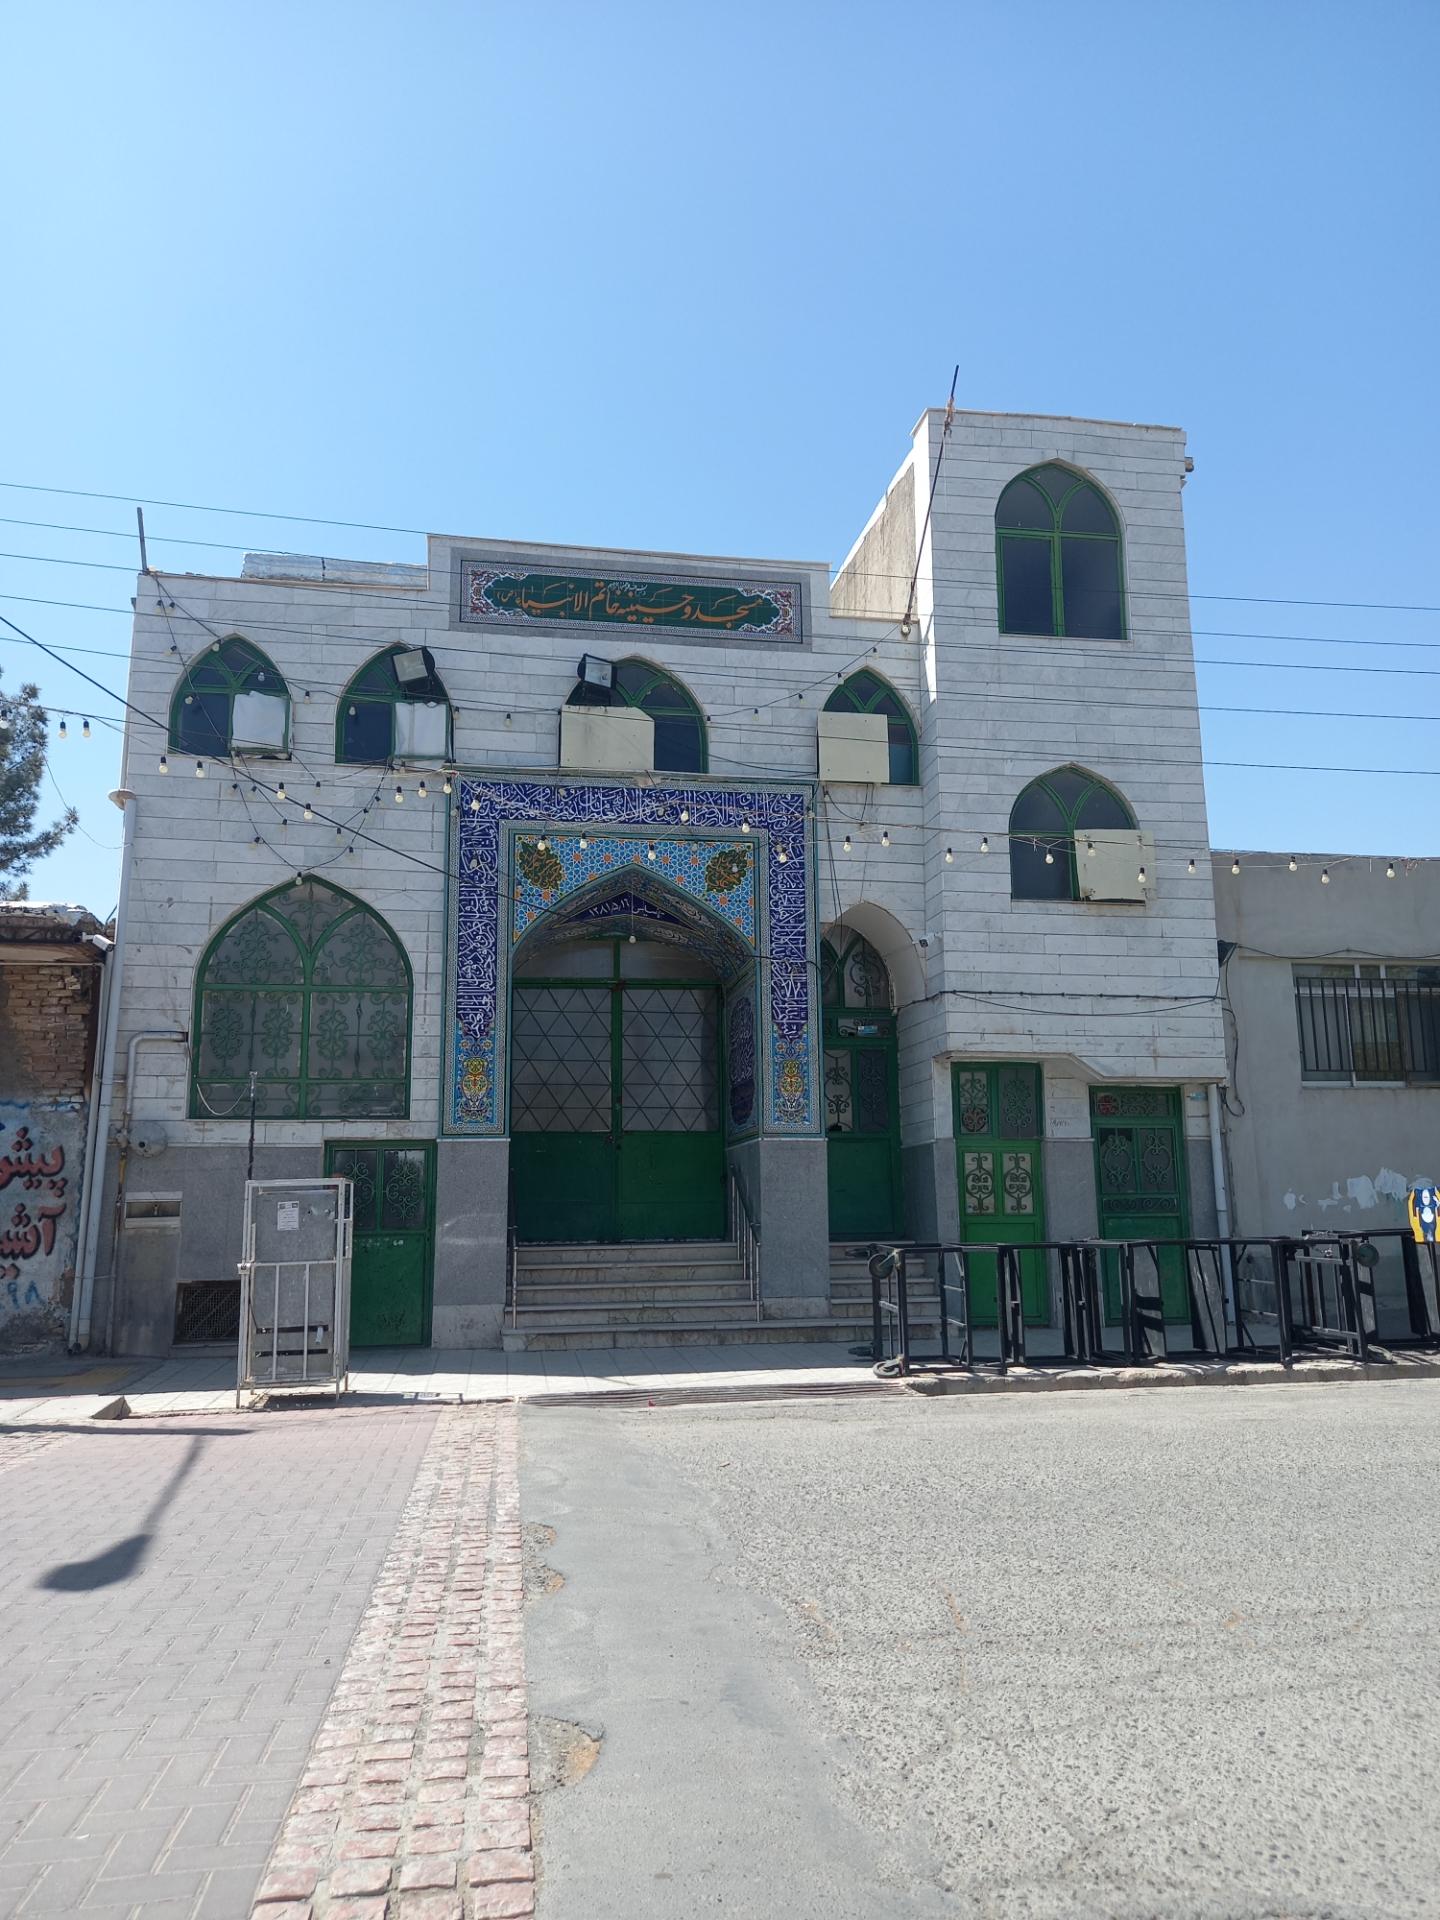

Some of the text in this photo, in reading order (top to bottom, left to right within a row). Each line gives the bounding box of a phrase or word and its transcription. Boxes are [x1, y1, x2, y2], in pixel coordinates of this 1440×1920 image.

[588, 580, 621, 620] خاتم
[617, 587, 696, 624] حسینیه
[690, 594, 764, 629] مسجد
